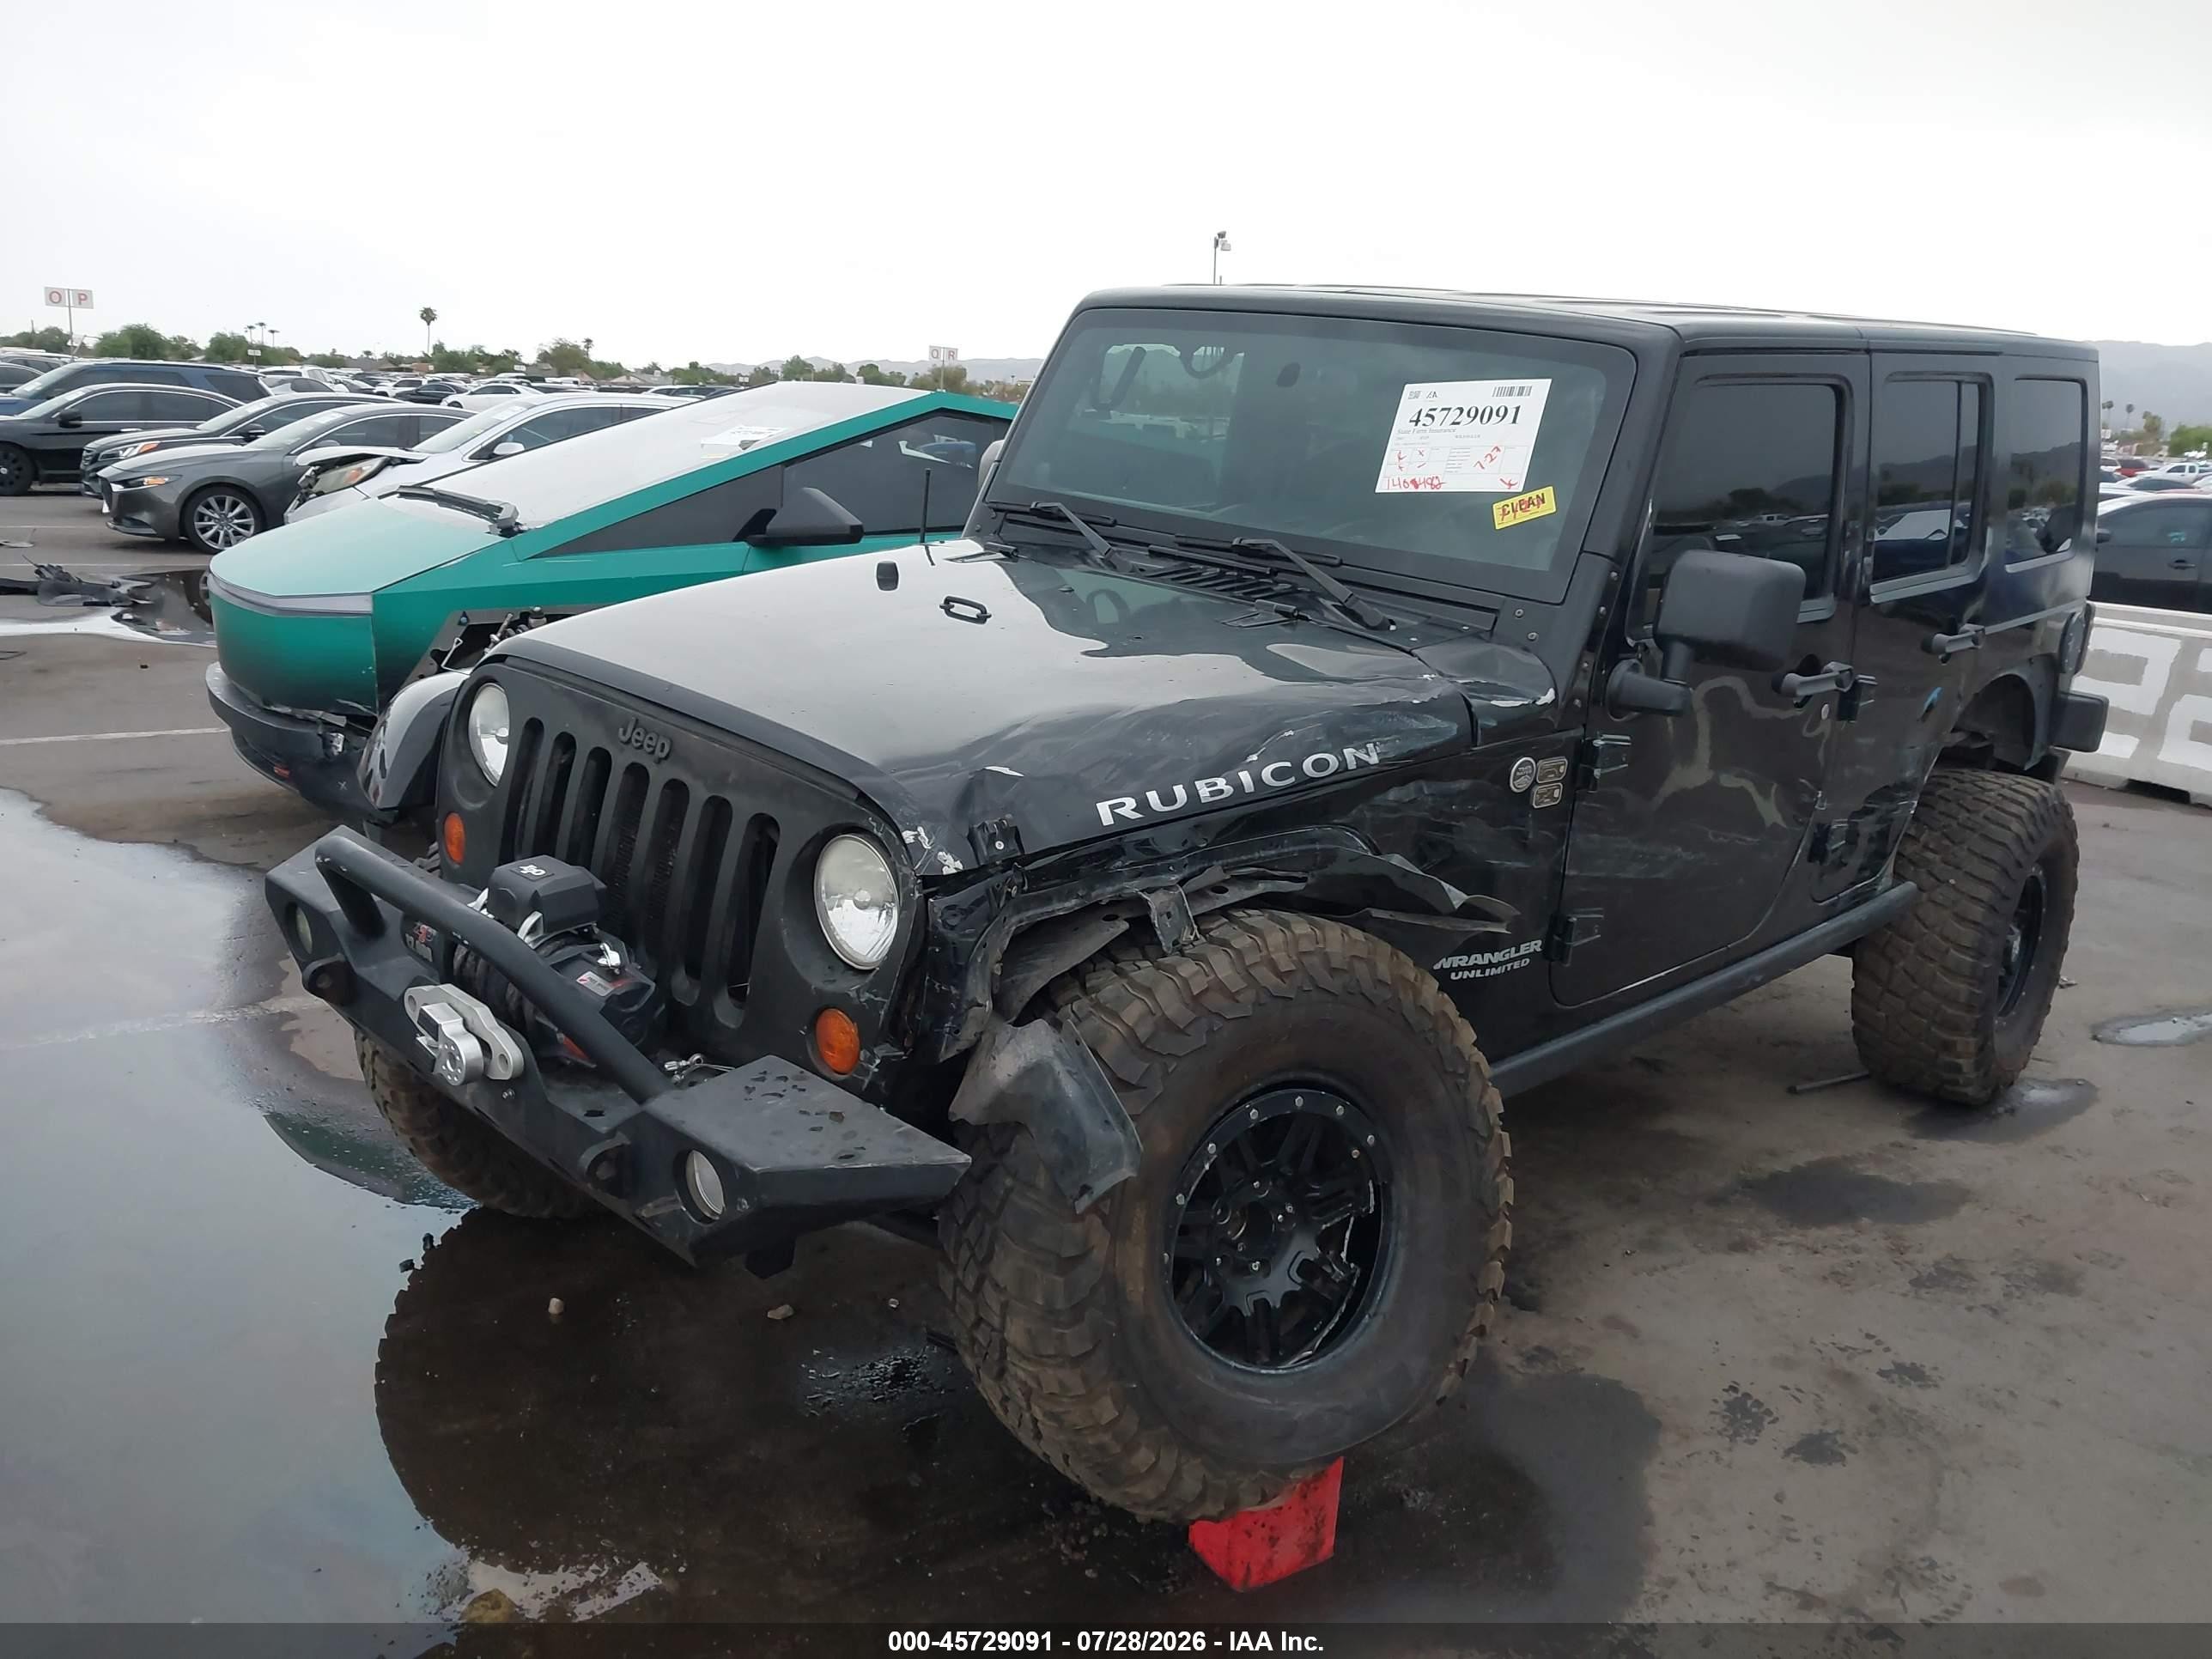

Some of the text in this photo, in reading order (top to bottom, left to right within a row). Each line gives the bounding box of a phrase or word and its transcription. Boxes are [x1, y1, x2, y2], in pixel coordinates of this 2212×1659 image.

[49, 290, 88, 306] O P
[948, 349, 956, 361] R
[1408, 404, 1522, 427] 45729091
[1501, 492, 1546, 515] CLEAN
[618, 717, 673, 764] Jeep
[1096, 743, 1380, 826] RUBICON
[1433, 939, 1543, 970] WRANGLER
[1450, 957, 1530, 981] UNLIMITED
